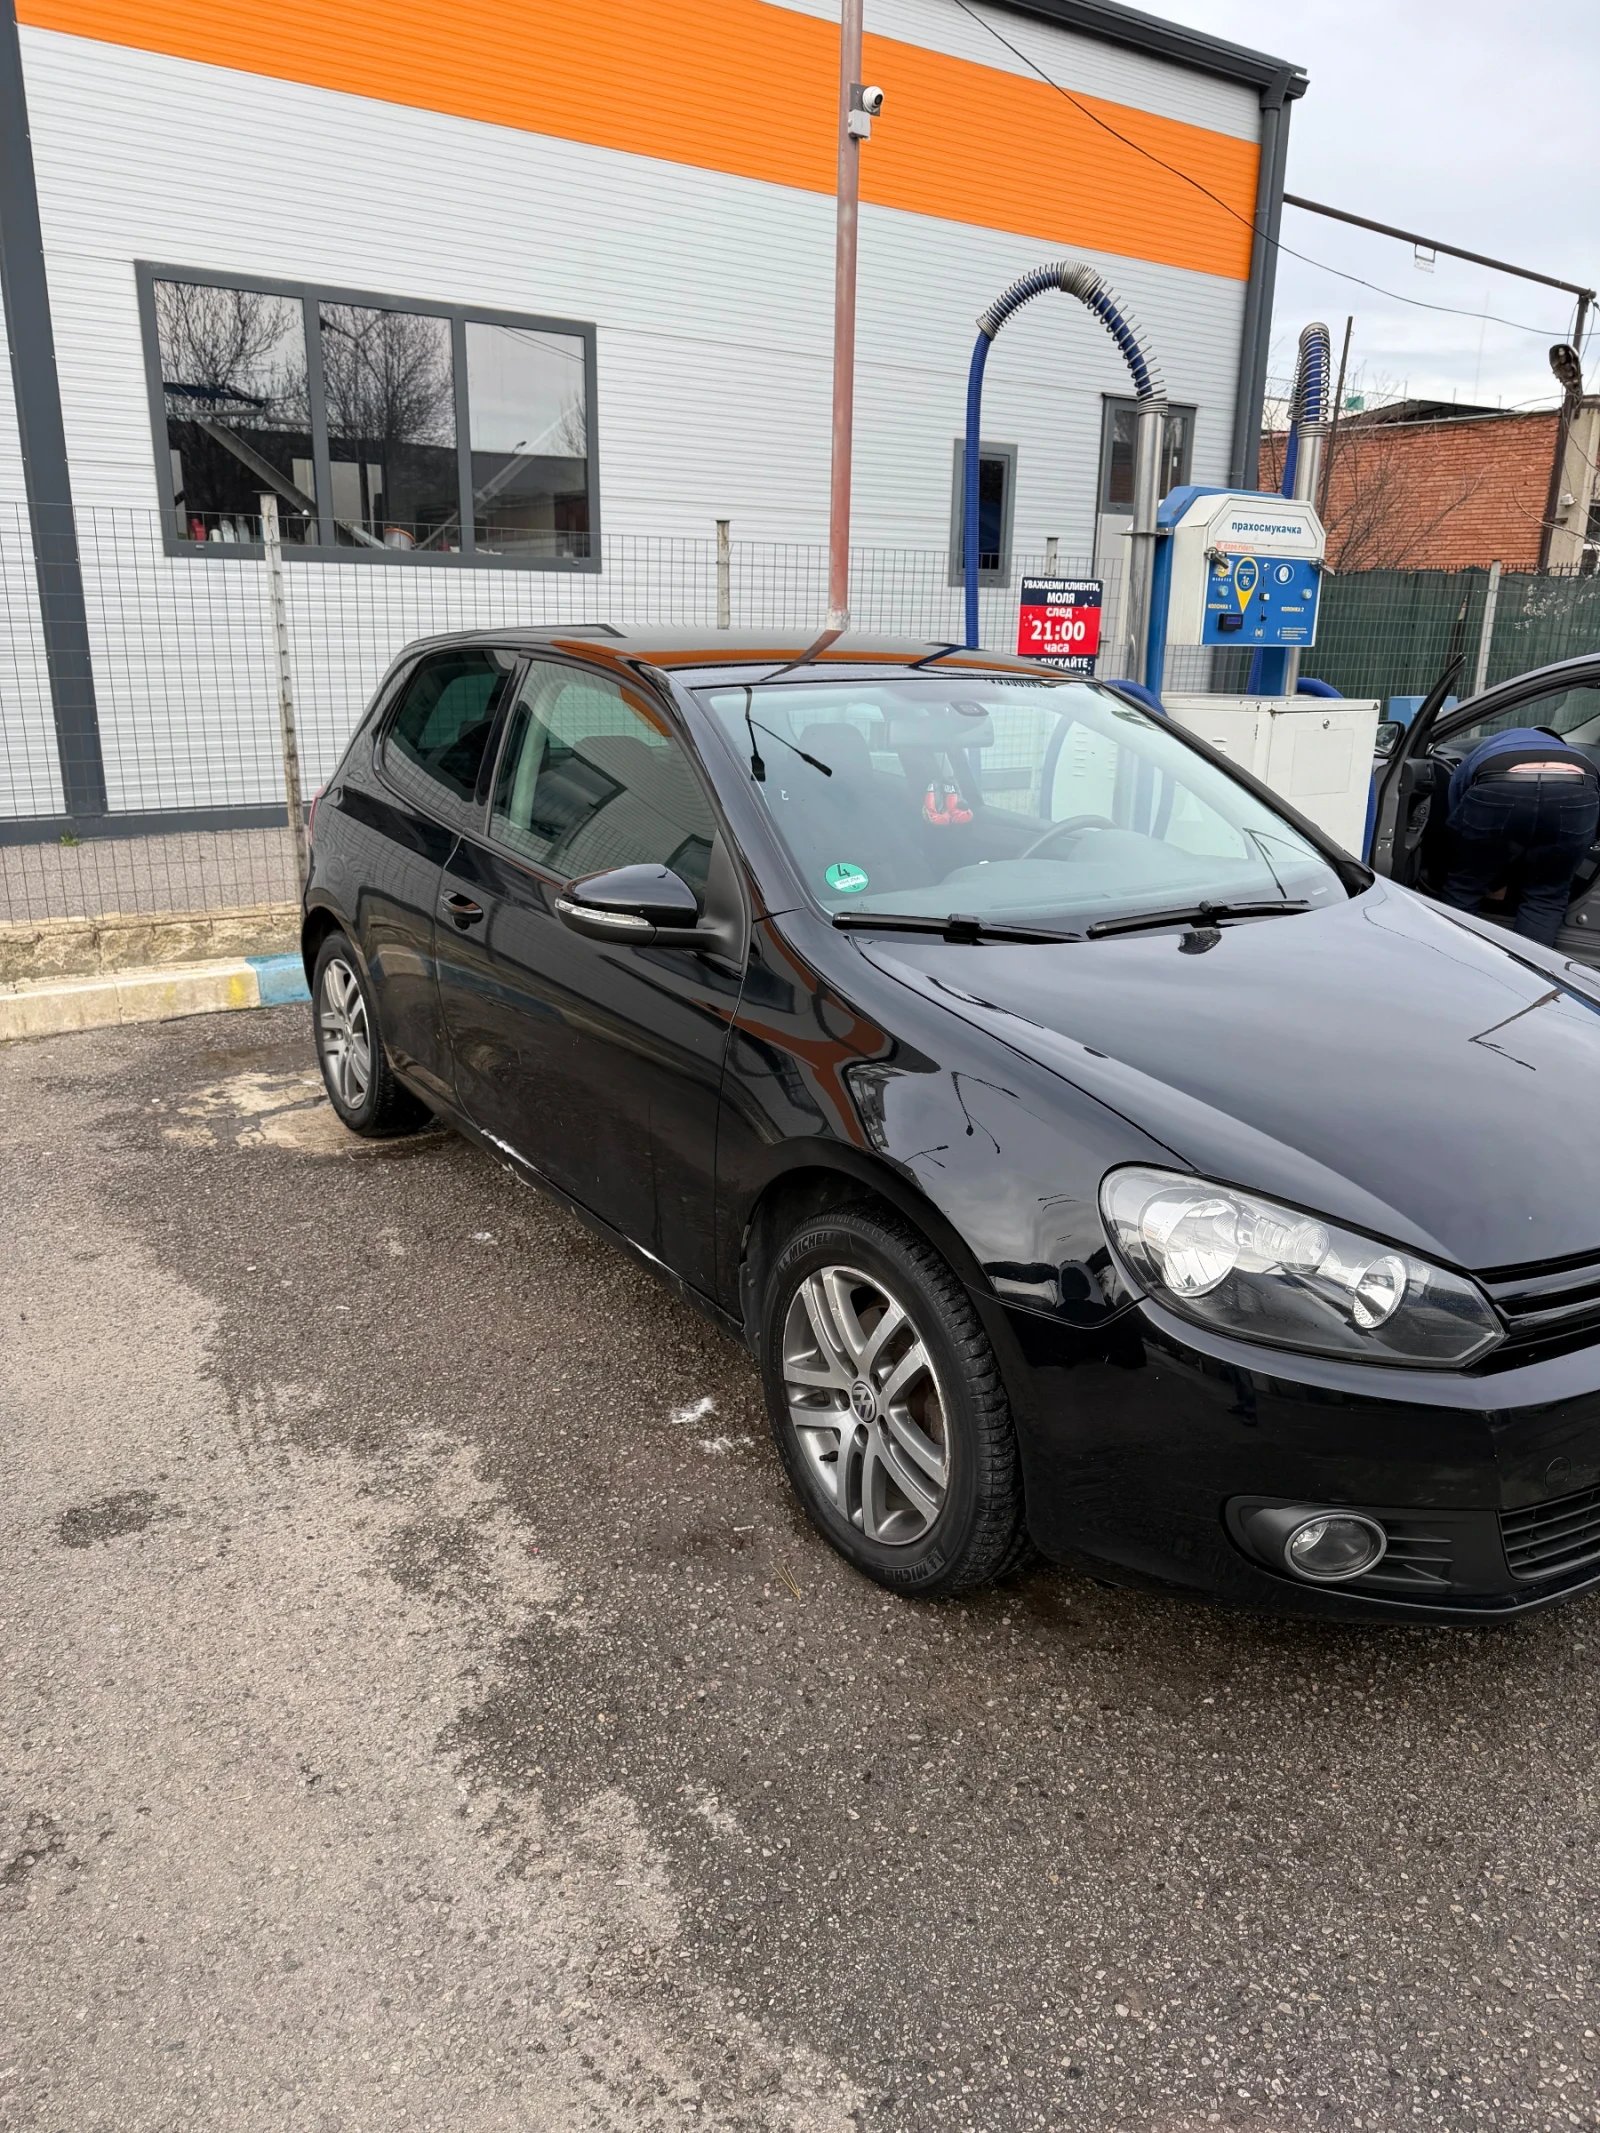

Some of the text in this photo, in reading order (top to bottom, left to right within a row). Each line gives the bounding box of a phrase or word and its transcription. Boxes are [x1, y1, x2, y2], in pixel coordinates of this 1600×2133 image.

[1232, 521, 1302, 534] прахосмукачка
[1024, 580, 1100, 592] УВАЖАЕМИ КЛИЕНТИ,
[1047, 592, 1075, 604] МОЛЯ
[1046, 607, 1073, 619] след
[1031, 620, 1086, 641] 21:00
[1044, 643, 1070, 653] часа
